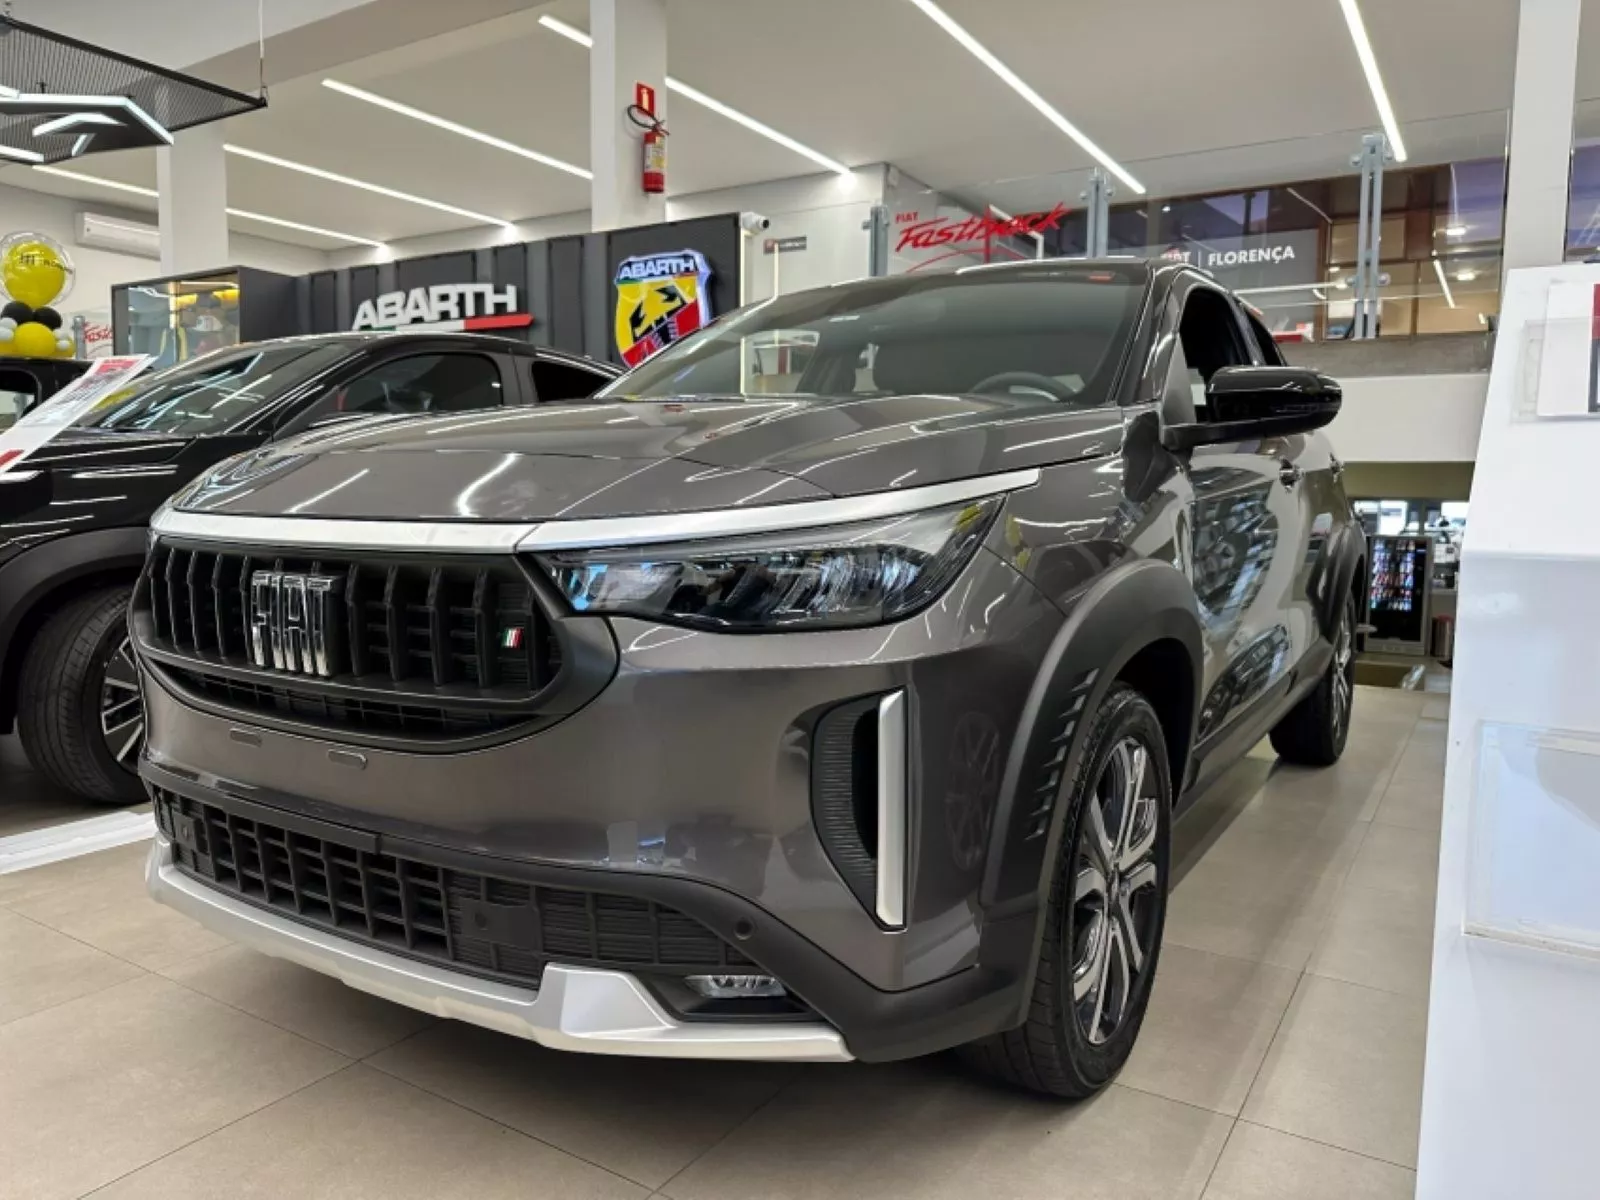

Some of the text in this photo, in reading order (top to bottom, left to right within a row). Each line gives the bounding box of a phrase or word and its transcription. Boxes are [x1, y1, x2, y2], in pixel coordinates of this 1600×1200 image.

[896, 211, 918, 224] FIAT
[1208, 246, 1295, 266] FLORENÇA
[620, 258, 695, 278] ABARTH
[352, 283, 517, 331] ABARTH
[251, 570, 332, 676] FIAT
